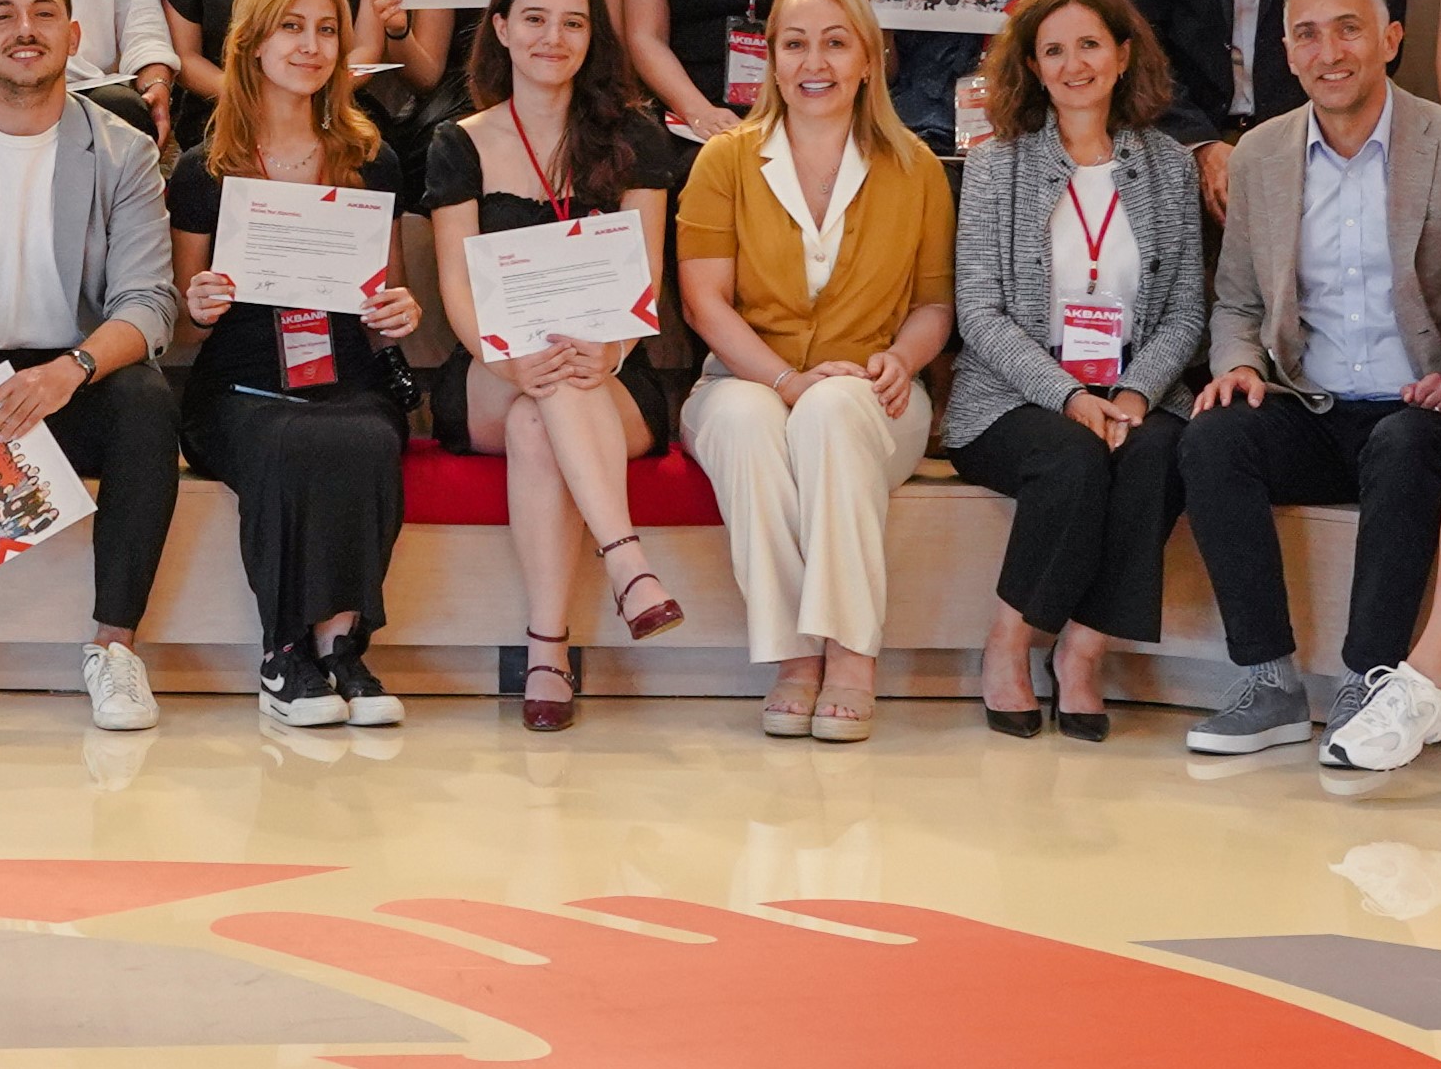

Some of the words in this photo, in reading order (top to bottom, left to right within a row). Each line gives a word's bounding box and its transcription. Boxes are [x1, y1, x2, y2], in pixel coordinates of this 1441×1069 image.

[346, 202, 382, 210] AKBANK
[281, 311, 327, 324] AKBANK
[1064, 308, 1123, 320] AKBANK
